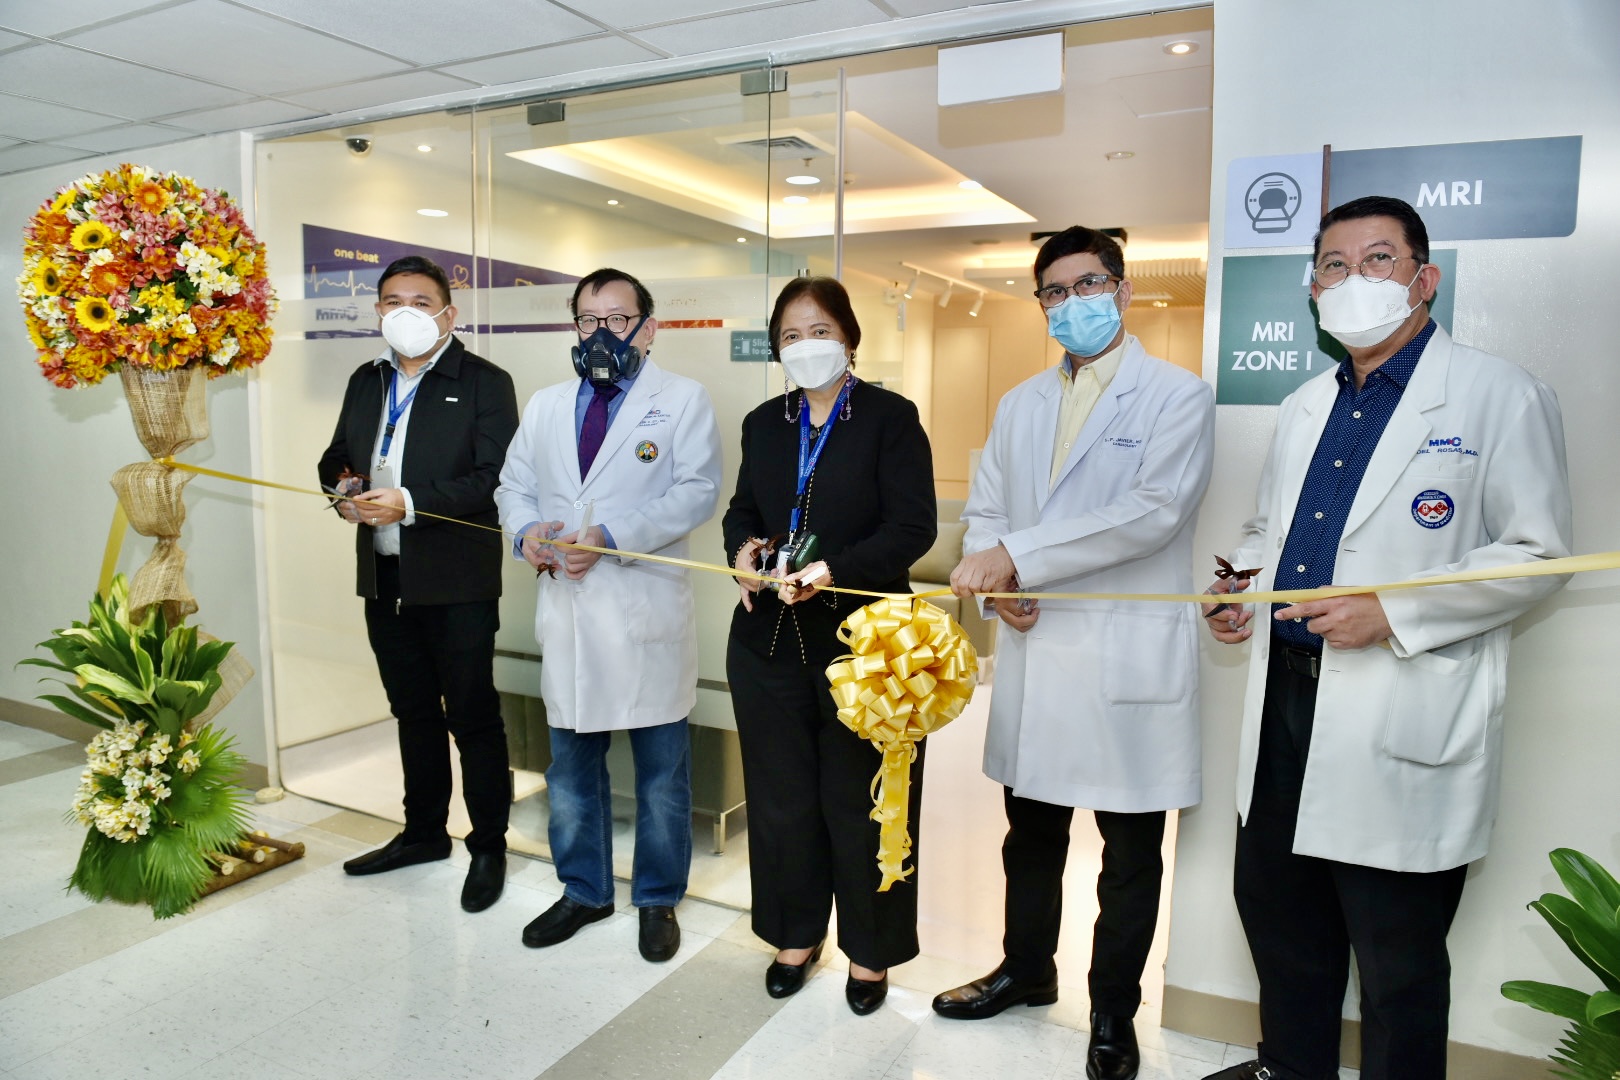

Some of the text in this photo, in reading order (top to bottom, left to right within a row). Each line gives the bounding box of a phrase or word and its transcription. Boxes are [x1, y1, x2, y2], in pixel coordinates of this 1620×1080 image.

[1416, 180, 1483, 208] MRI
[334, 248, 379, 263] one beat
[1251, 321, 1295, 342] MRI
[1231, 350, 1313, 371] ZONE I
[1429, 437, 1462, 447] MMC
